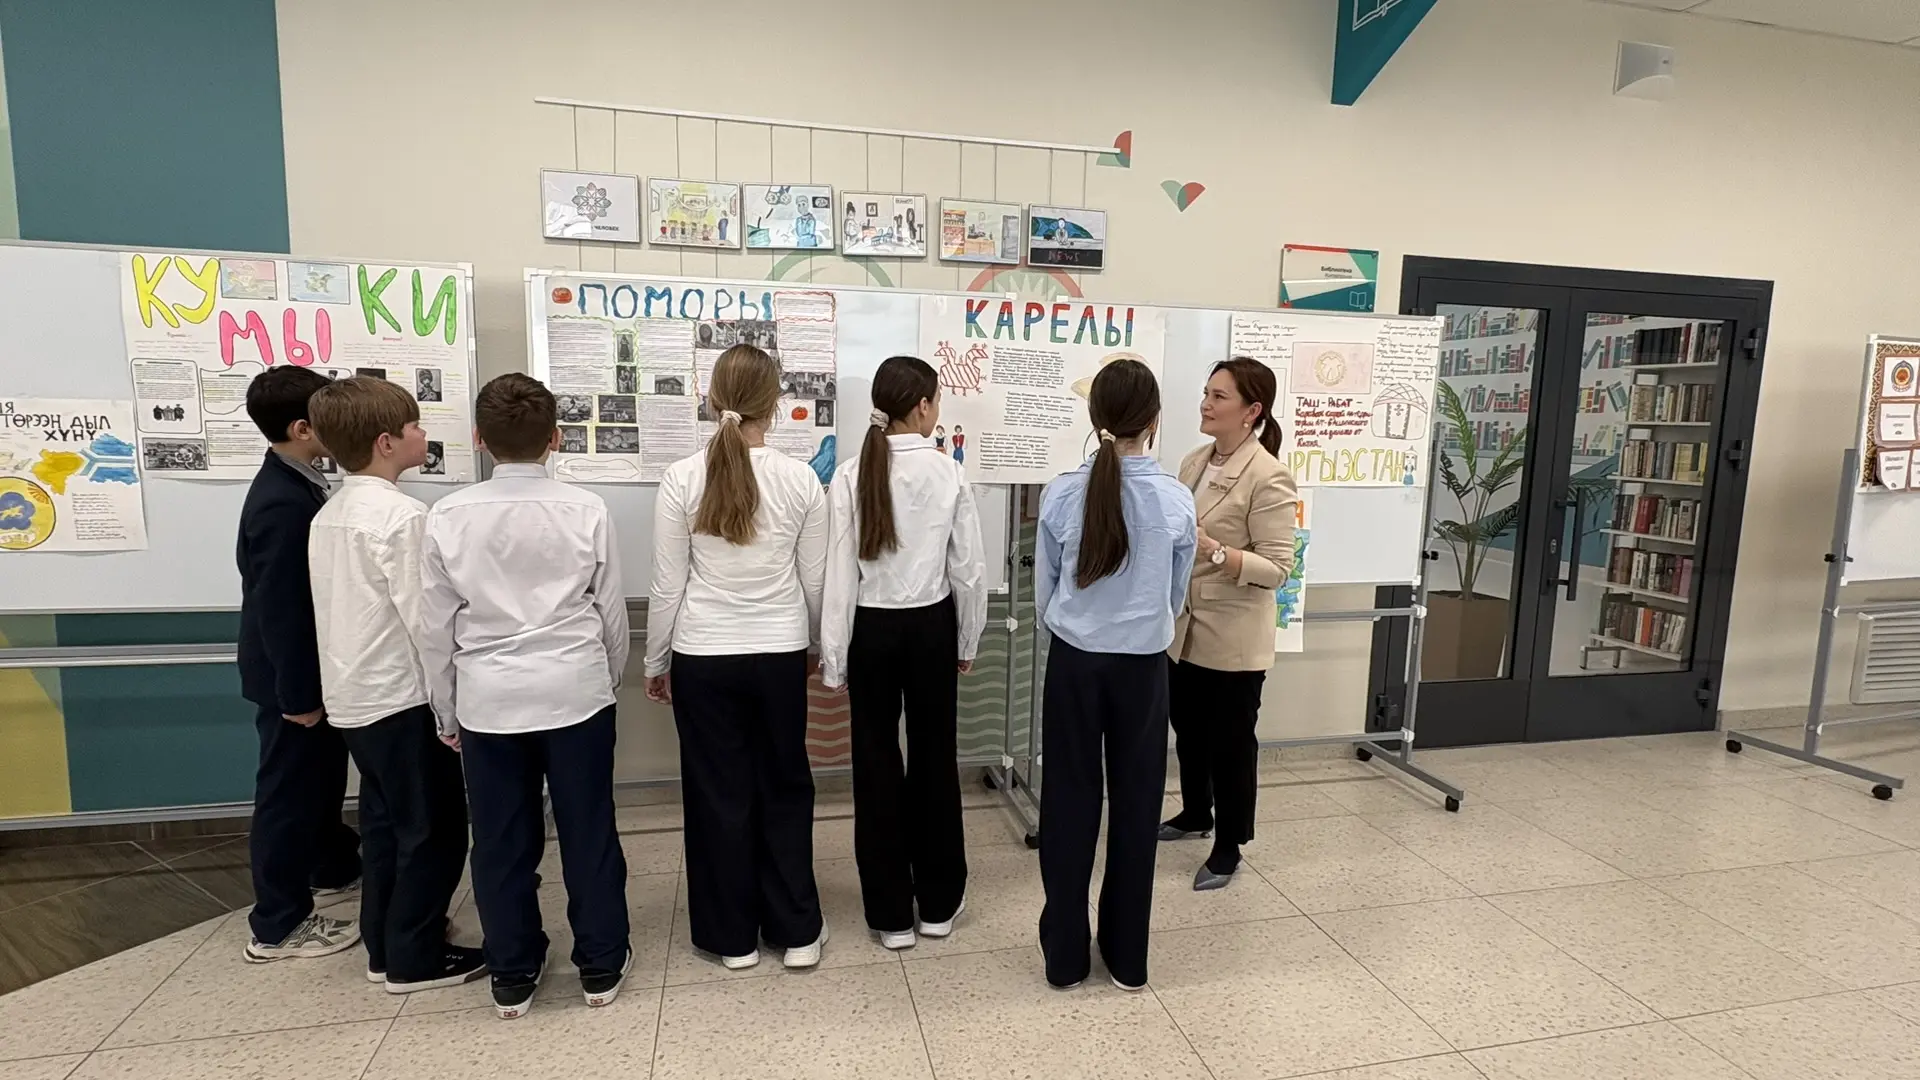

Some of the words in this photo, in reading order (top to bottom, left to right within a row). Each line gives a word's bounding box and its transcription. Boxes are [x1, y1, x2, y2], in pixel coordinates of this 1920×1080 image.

[577, 283, 773, 322] ПОМОРЫ
[965, 298, 1134, 347] КАРЕЛЫ
[70, 415, 111, 429] ДЫЛ
